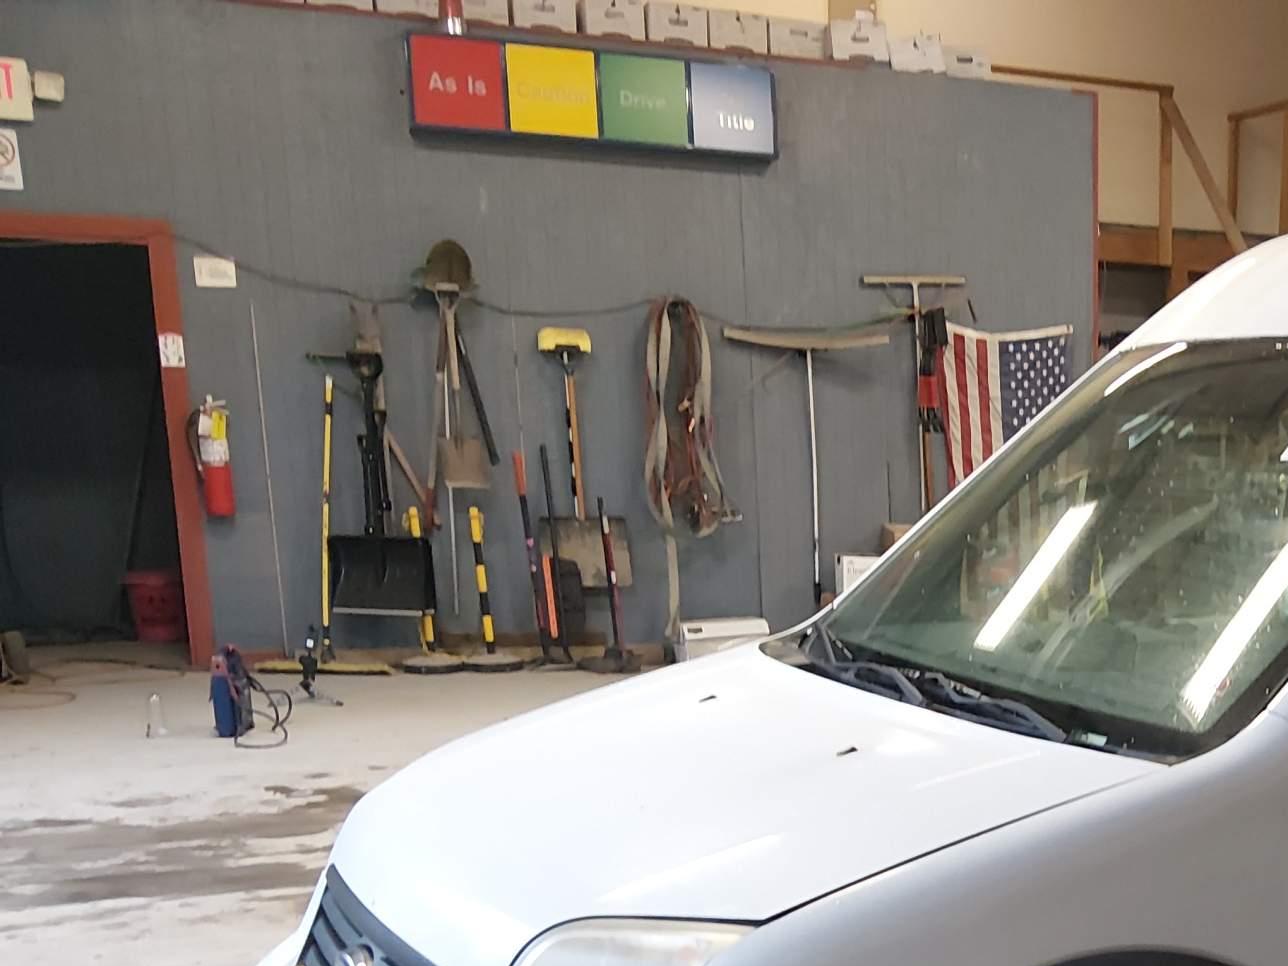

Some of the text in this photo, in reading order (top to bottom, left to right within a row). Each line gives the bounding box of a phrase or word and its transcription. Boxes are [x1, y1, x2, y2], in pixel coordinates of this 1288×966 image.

[428, 71, 487, 97] As Is
[619, 89, 667, 110] Drive
